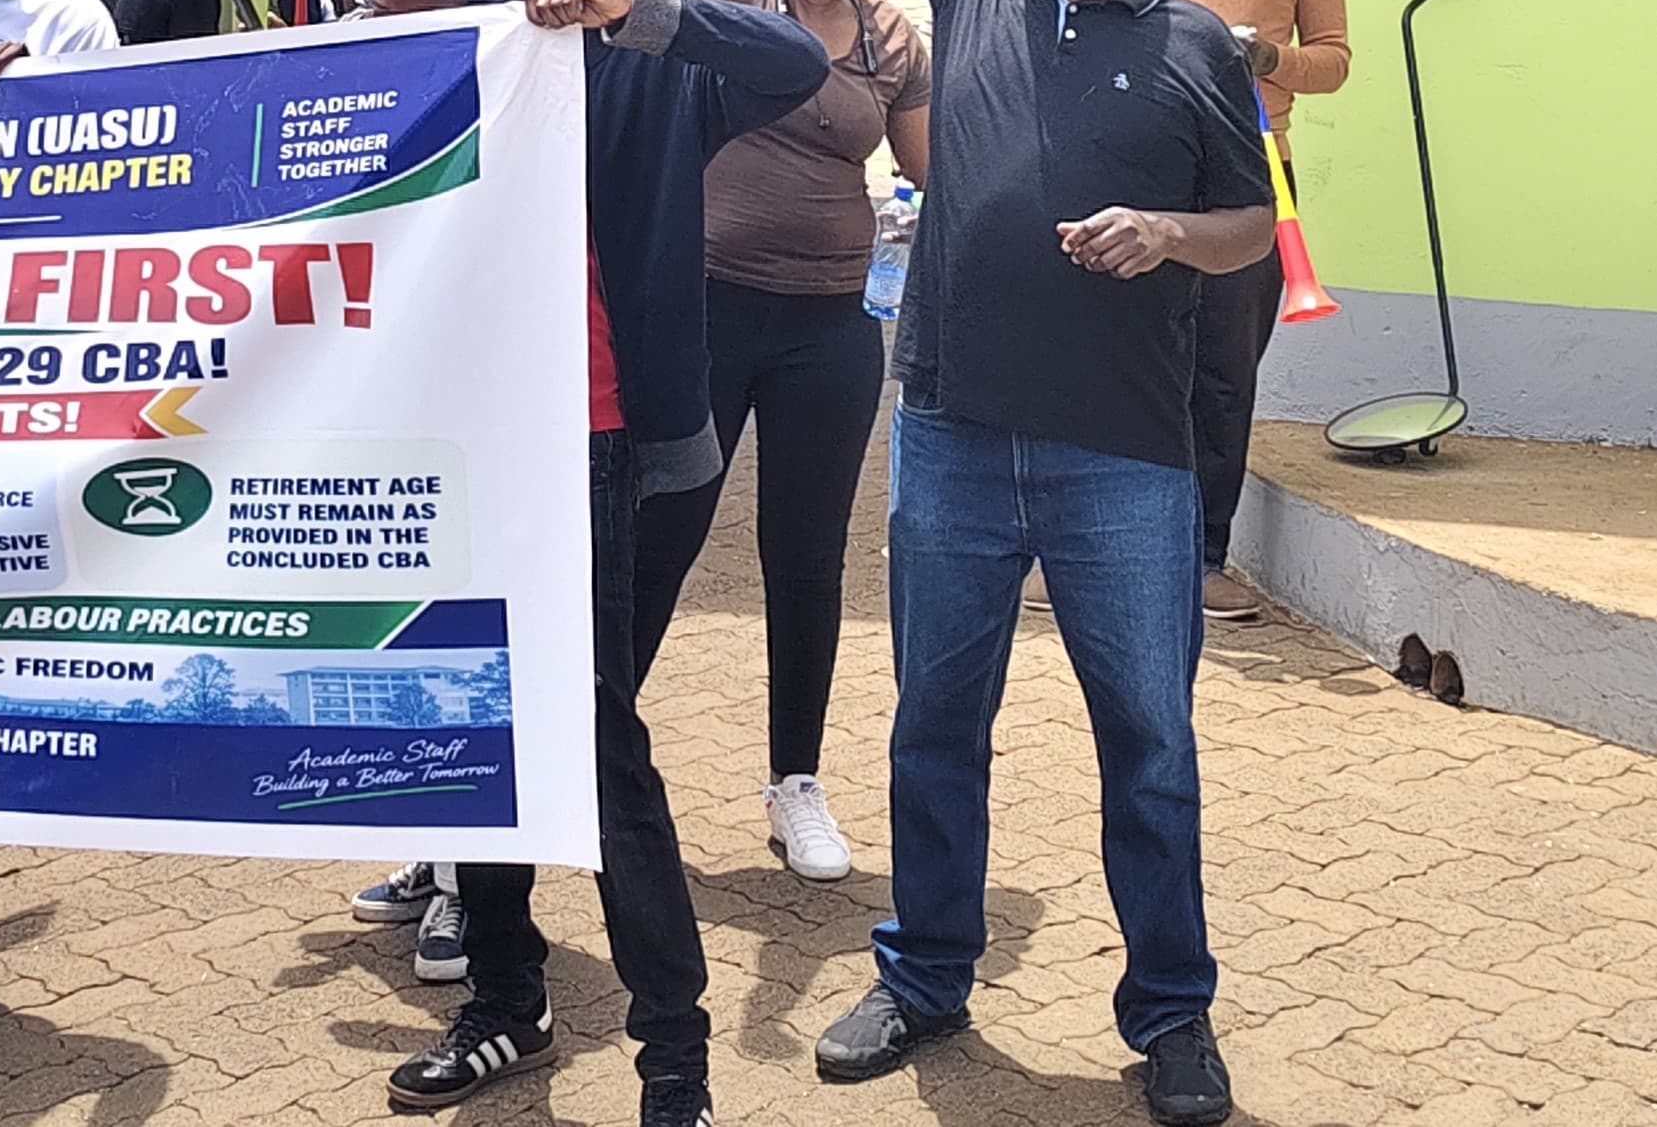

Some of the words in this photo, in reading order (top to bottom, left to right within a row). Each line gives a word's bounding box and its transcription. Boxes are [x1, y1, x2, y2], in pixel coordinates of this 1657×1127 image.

[282, 90, 399, 119] ACADEMIC
[27, 104, 177, 156] (UASU)
[281, 117, 352, 139] STAFF
[279, 133, 389, 160] STRONGER
[29, 153, 193, 196] CHAPTER
[278, 155, 388, 182] TOGETHER
[4, 242, 374, 330] FIRST!
[82, 338, 229, 384] CBA!
[230, 477, 380, 496] RETIREMENT
[388, 475, 442, 495] AGE
[229, 503, 294, 520] MUST
[298, 502, 394, 521] REMAIN
[402, 502, 436, 520] AS
[228, 527, 338, 544] PROVIDED
[346, 527, 373, 544] IN
[379, 526, 429, 544] THE
[226, 551, 369, 569] CONCLUDED
[377, 551, 430, 569] CBA
[126, 608, 311, 638] PRACTICES
[15, 657, 154, 682] FREEDOM
[288, 746, 396, 772] Academic
[402, 738, 469, 763] Staff
[252, 774, 330, 798] Building
[337, 775, 350, 788] a
[355, 766, 413, 790] Better
[420, 761, 500, 781] Tomorrow
